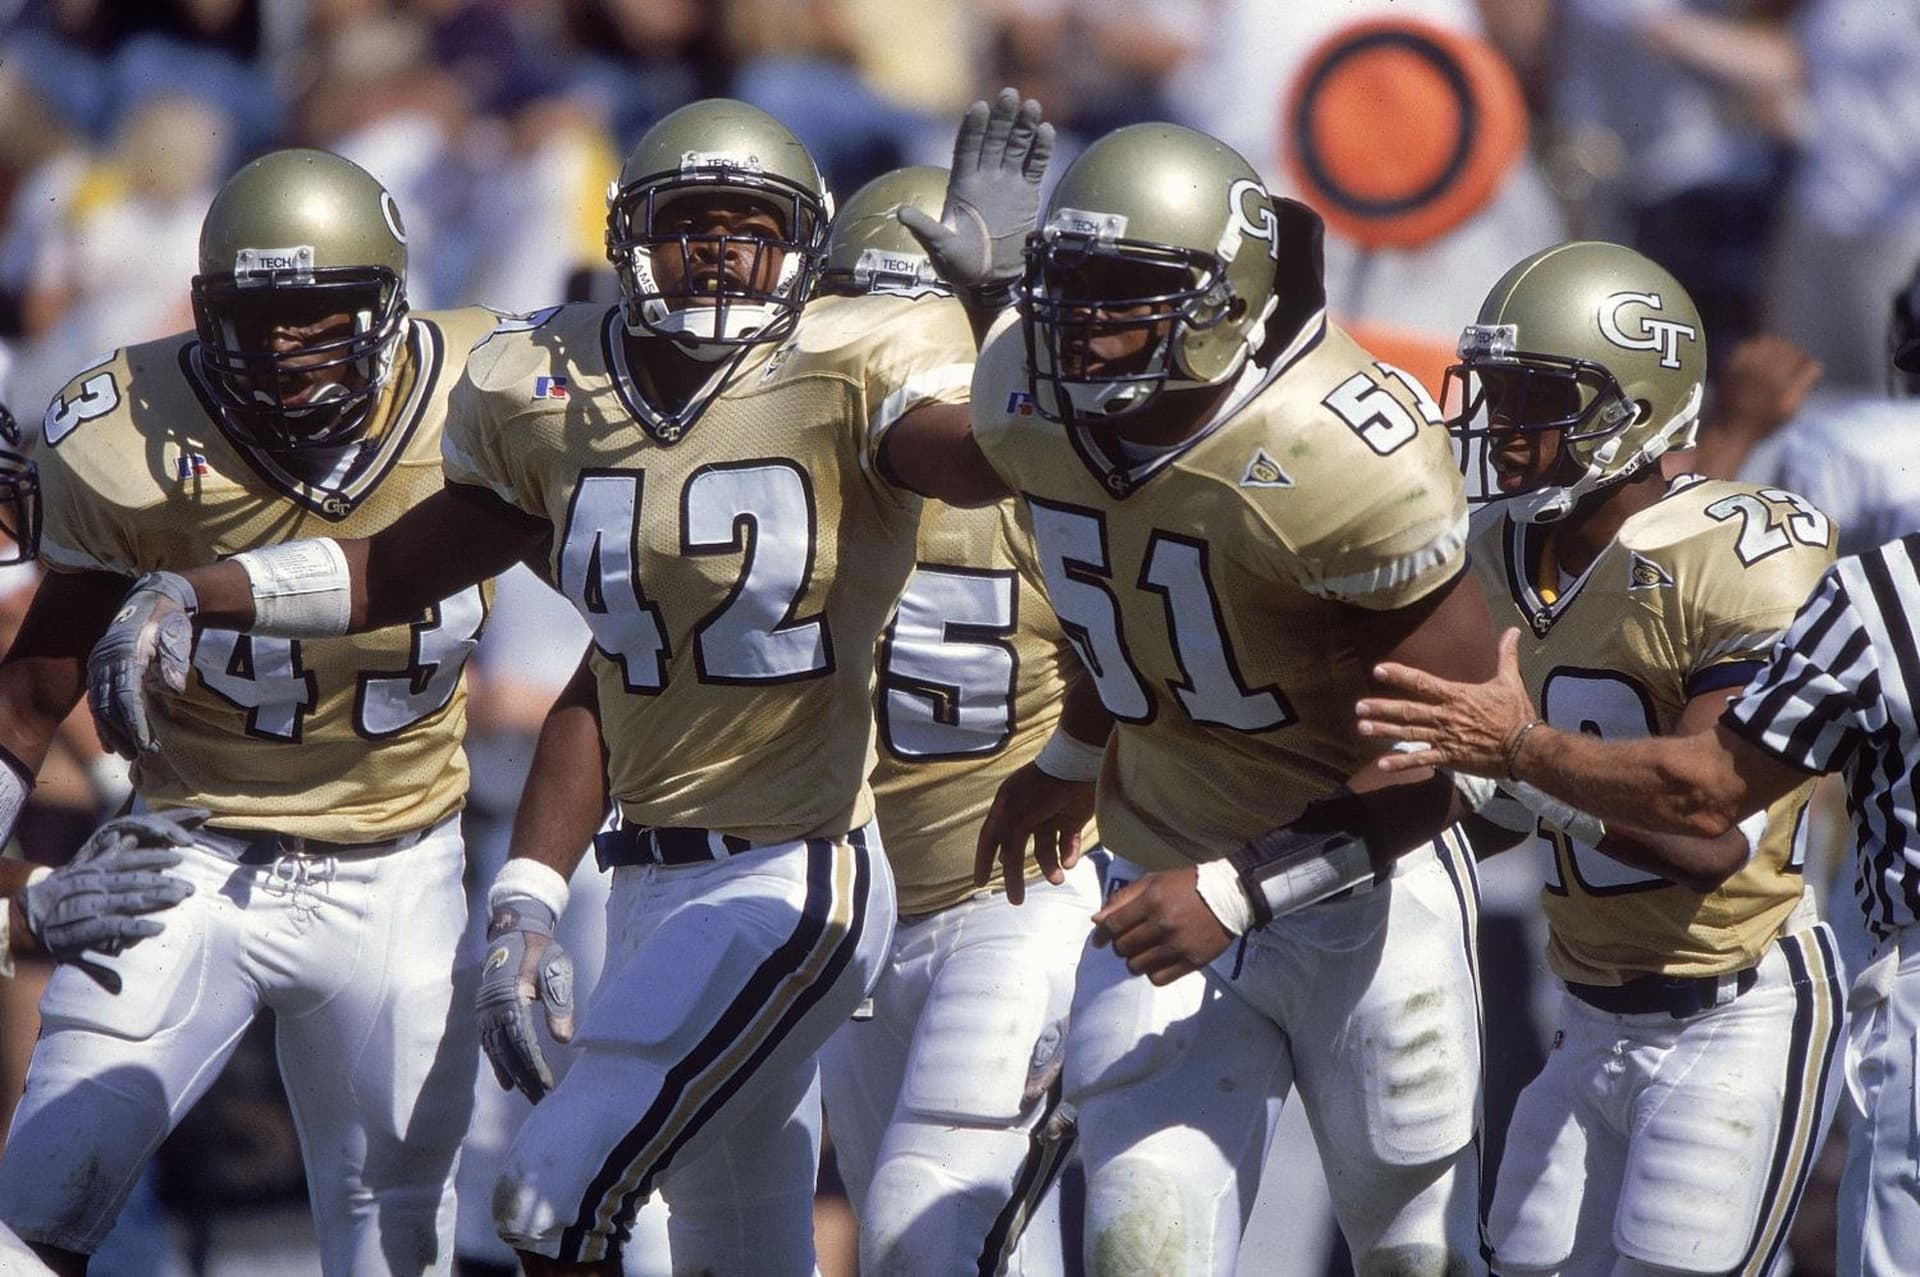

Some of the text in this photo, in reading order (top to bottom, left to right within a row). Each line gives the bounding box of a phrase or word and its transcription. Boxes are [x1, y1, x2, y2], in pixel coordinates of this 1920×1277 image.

[258, 257, 293, 269] TECH
[882, 259, 914, 273] TECH
[1597, 291, 1696, 370] GT
[44, 352, 121, 449] 3
[1704, 488, 1829, 569] 23
[556, 457, 836, 694] 42
[1021, 489, 1299, 734] 51
[190, 582, 485, 743] 43
